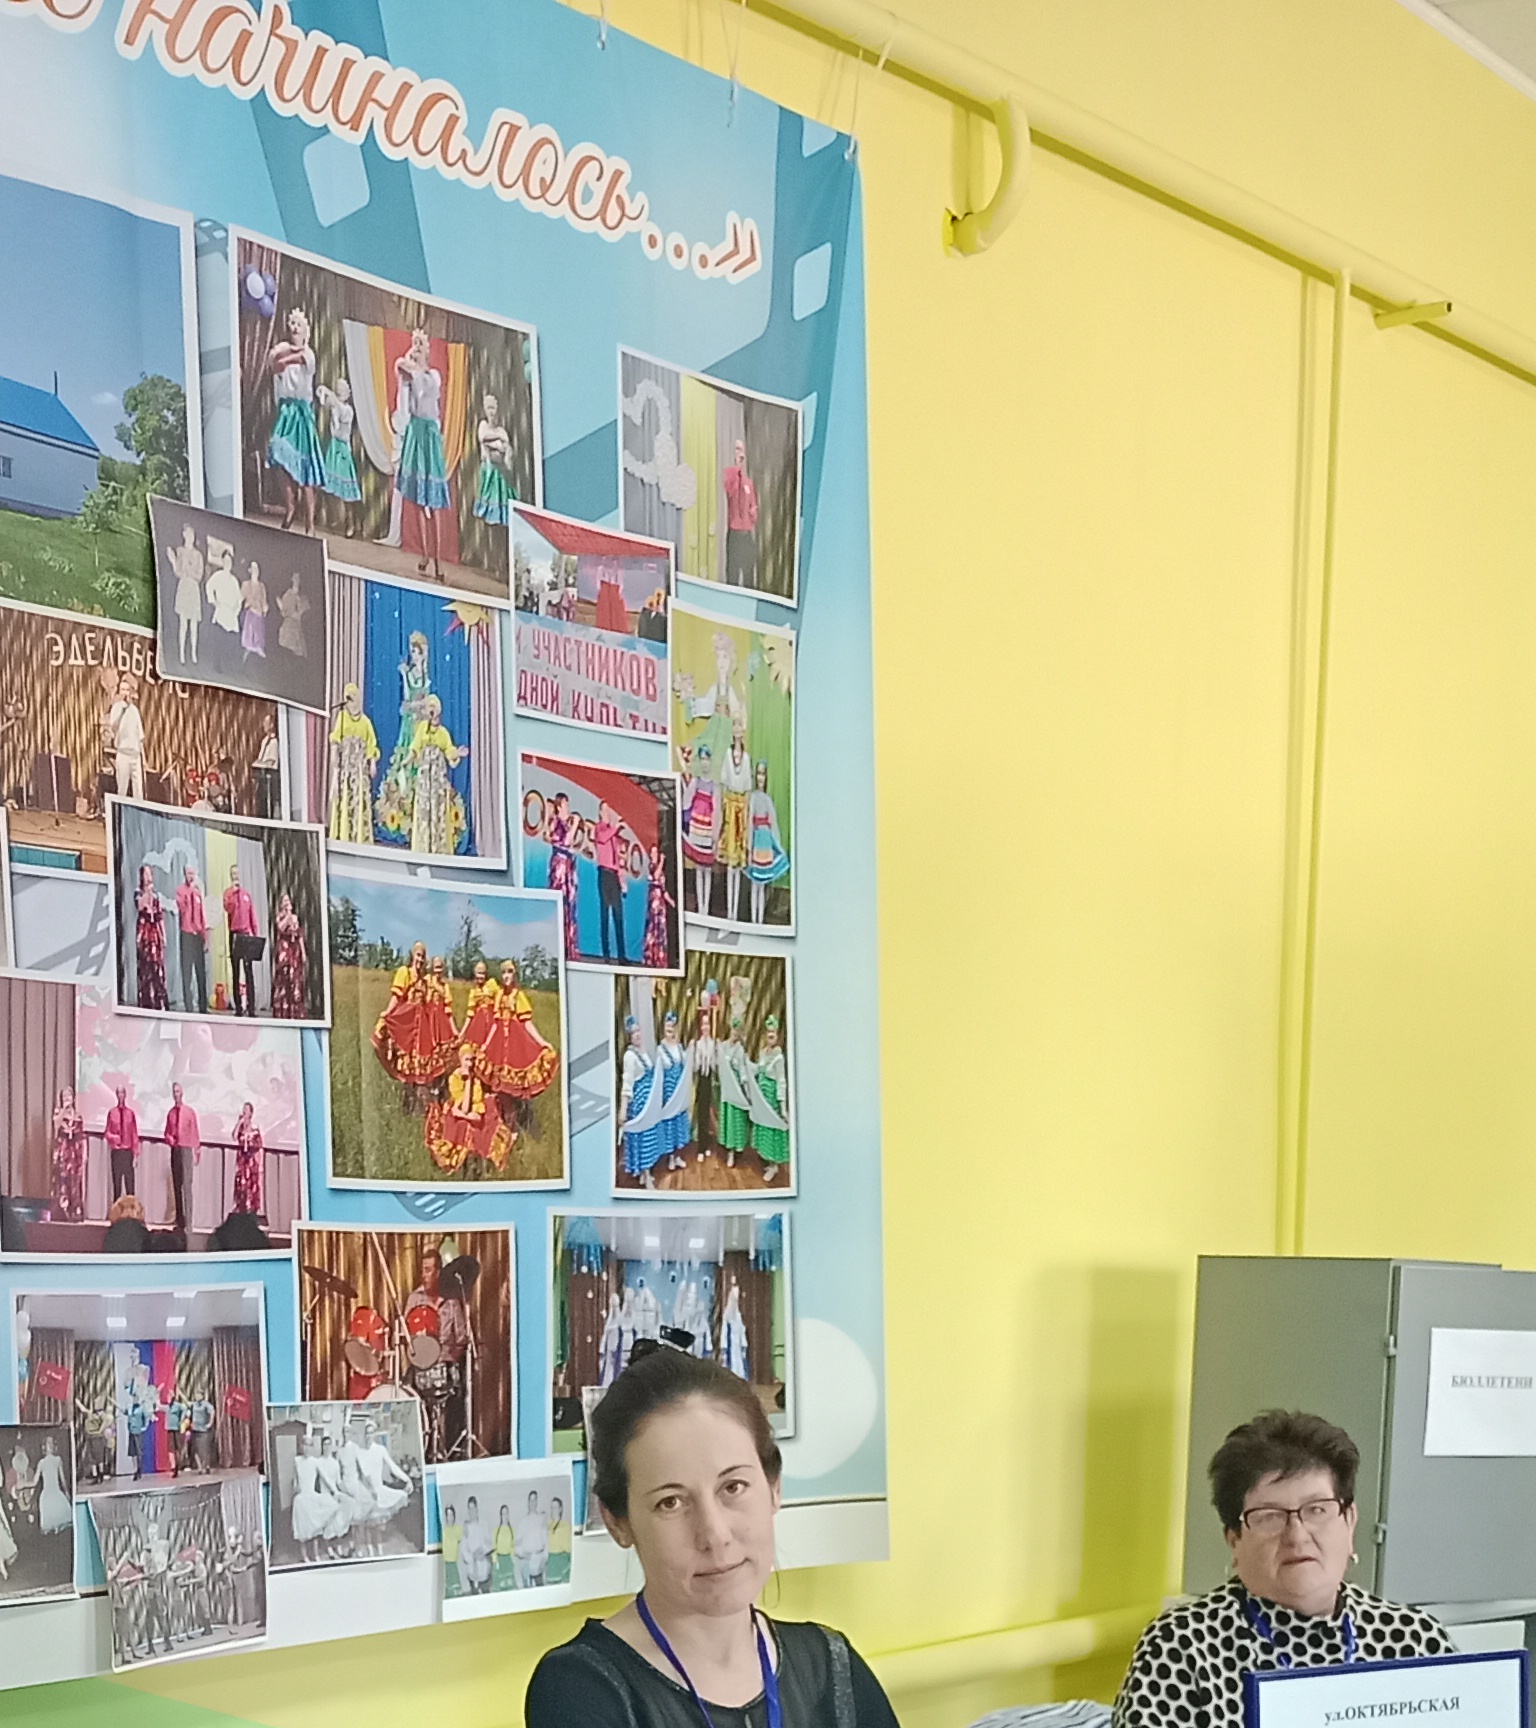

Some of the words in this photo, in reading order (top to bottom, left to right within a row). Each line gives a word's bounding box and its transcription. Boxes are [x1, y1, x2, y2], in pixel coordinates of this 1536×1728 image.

[45, 632, 189, 699] ЭДЕЛЬВЕ
[532, 628, 658, 702] УЧАСТНИКОВ
[1324, 1696, 1461, 1726] ул.ОКТЯБРЬСКАЯ
